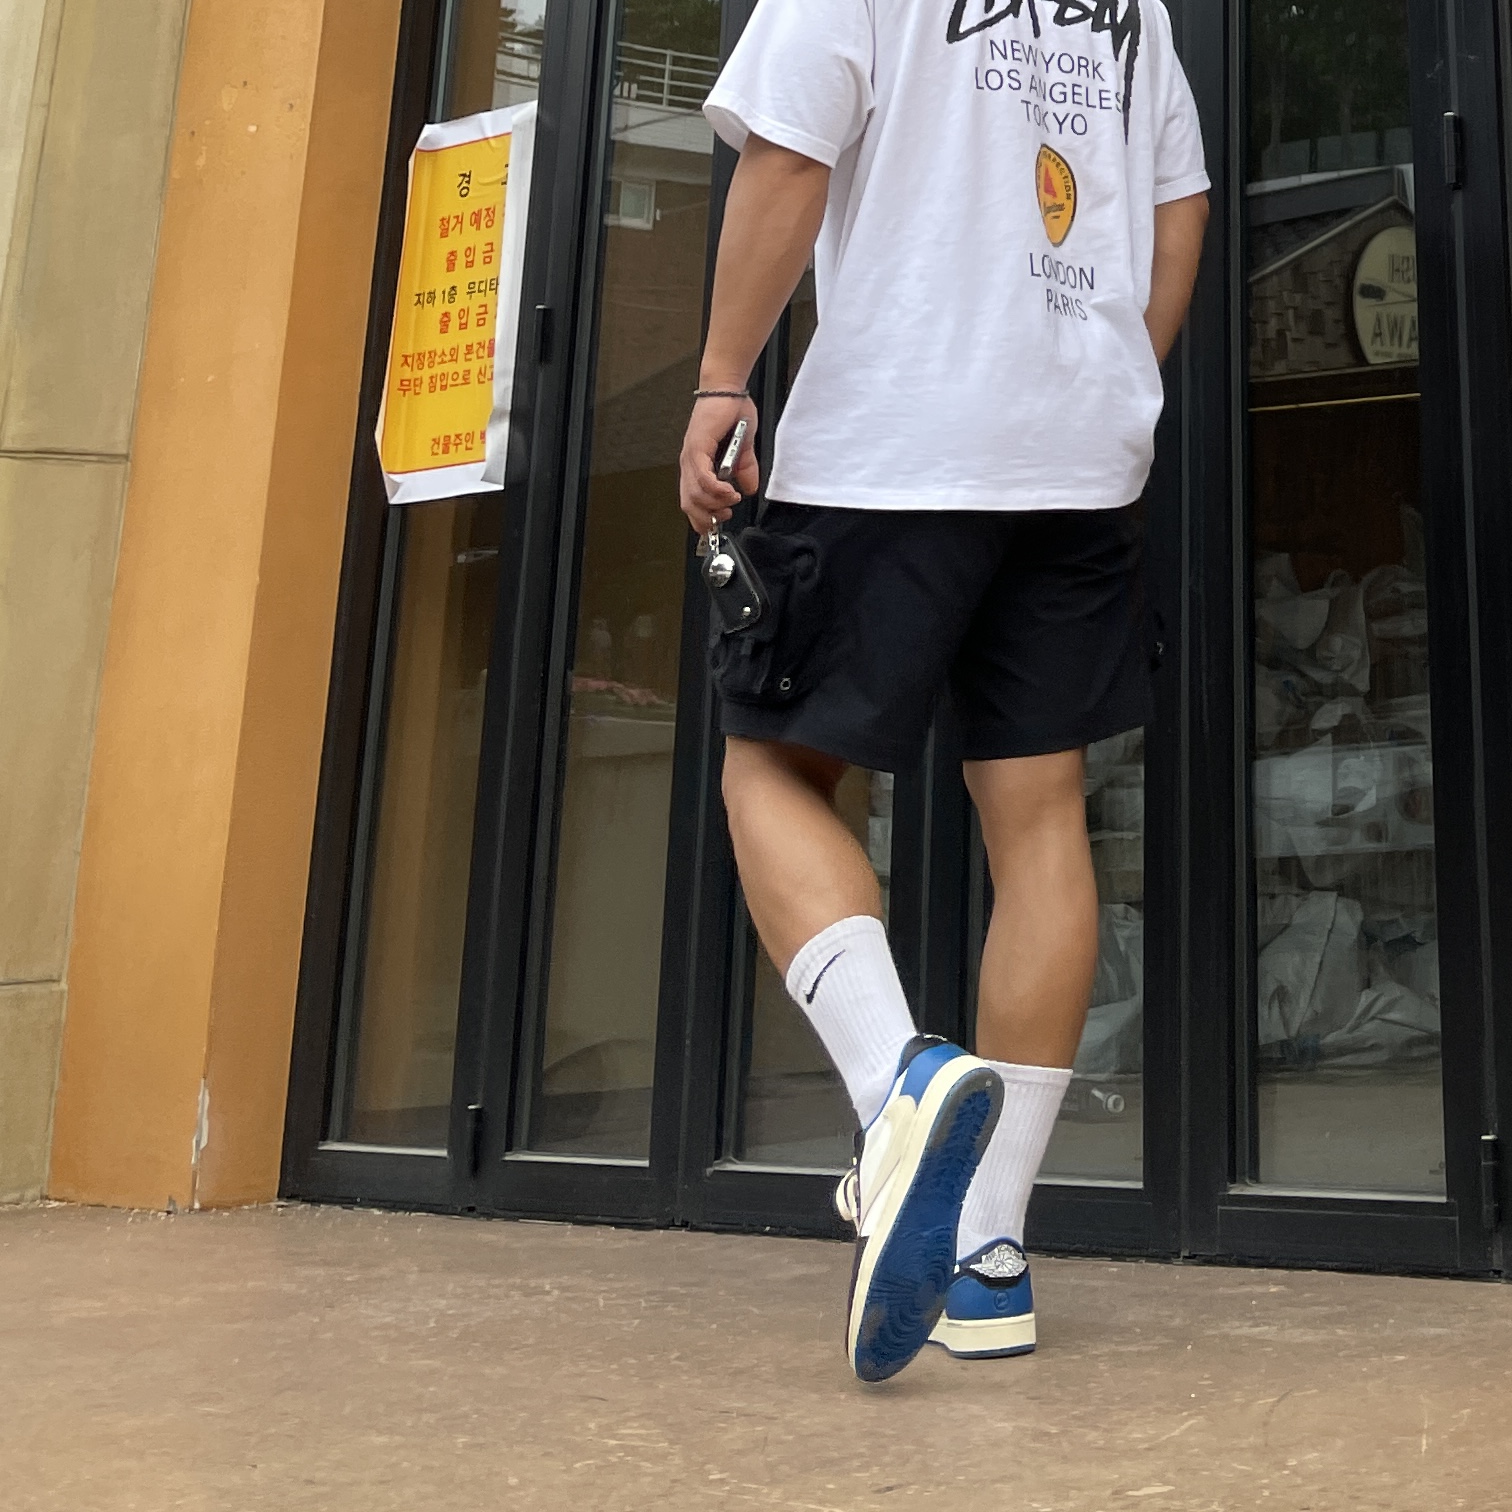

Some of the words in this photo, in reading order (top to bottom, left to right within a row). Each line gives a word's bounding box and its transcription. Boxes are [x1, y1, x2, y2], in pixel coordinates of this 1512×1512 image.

[989, 39, 1039, 68] NEW
[1041, 51, 1106, 83] YORK
[975, 67, 1022, 91] LOS
[1029, 74, 1123, 114] ANGELES
[1021, 99, 1088, 136] TOKYO
[457, 170, 472, 198] 경
[438, 212, 464, 239] 철거
[469, 205, 496, 231] 예정
[1029, 252, 1094, 291] LONDON
[414, 289, 437, 310] 지하
[441, 285, 458, 304] 1층
[1046, 288, 1088, 321] PARIS
[397, 376, 423, 397] 무단
[428, 369, 471, 393] 침입으로
[431, 431, 475, 456] 건물주인
